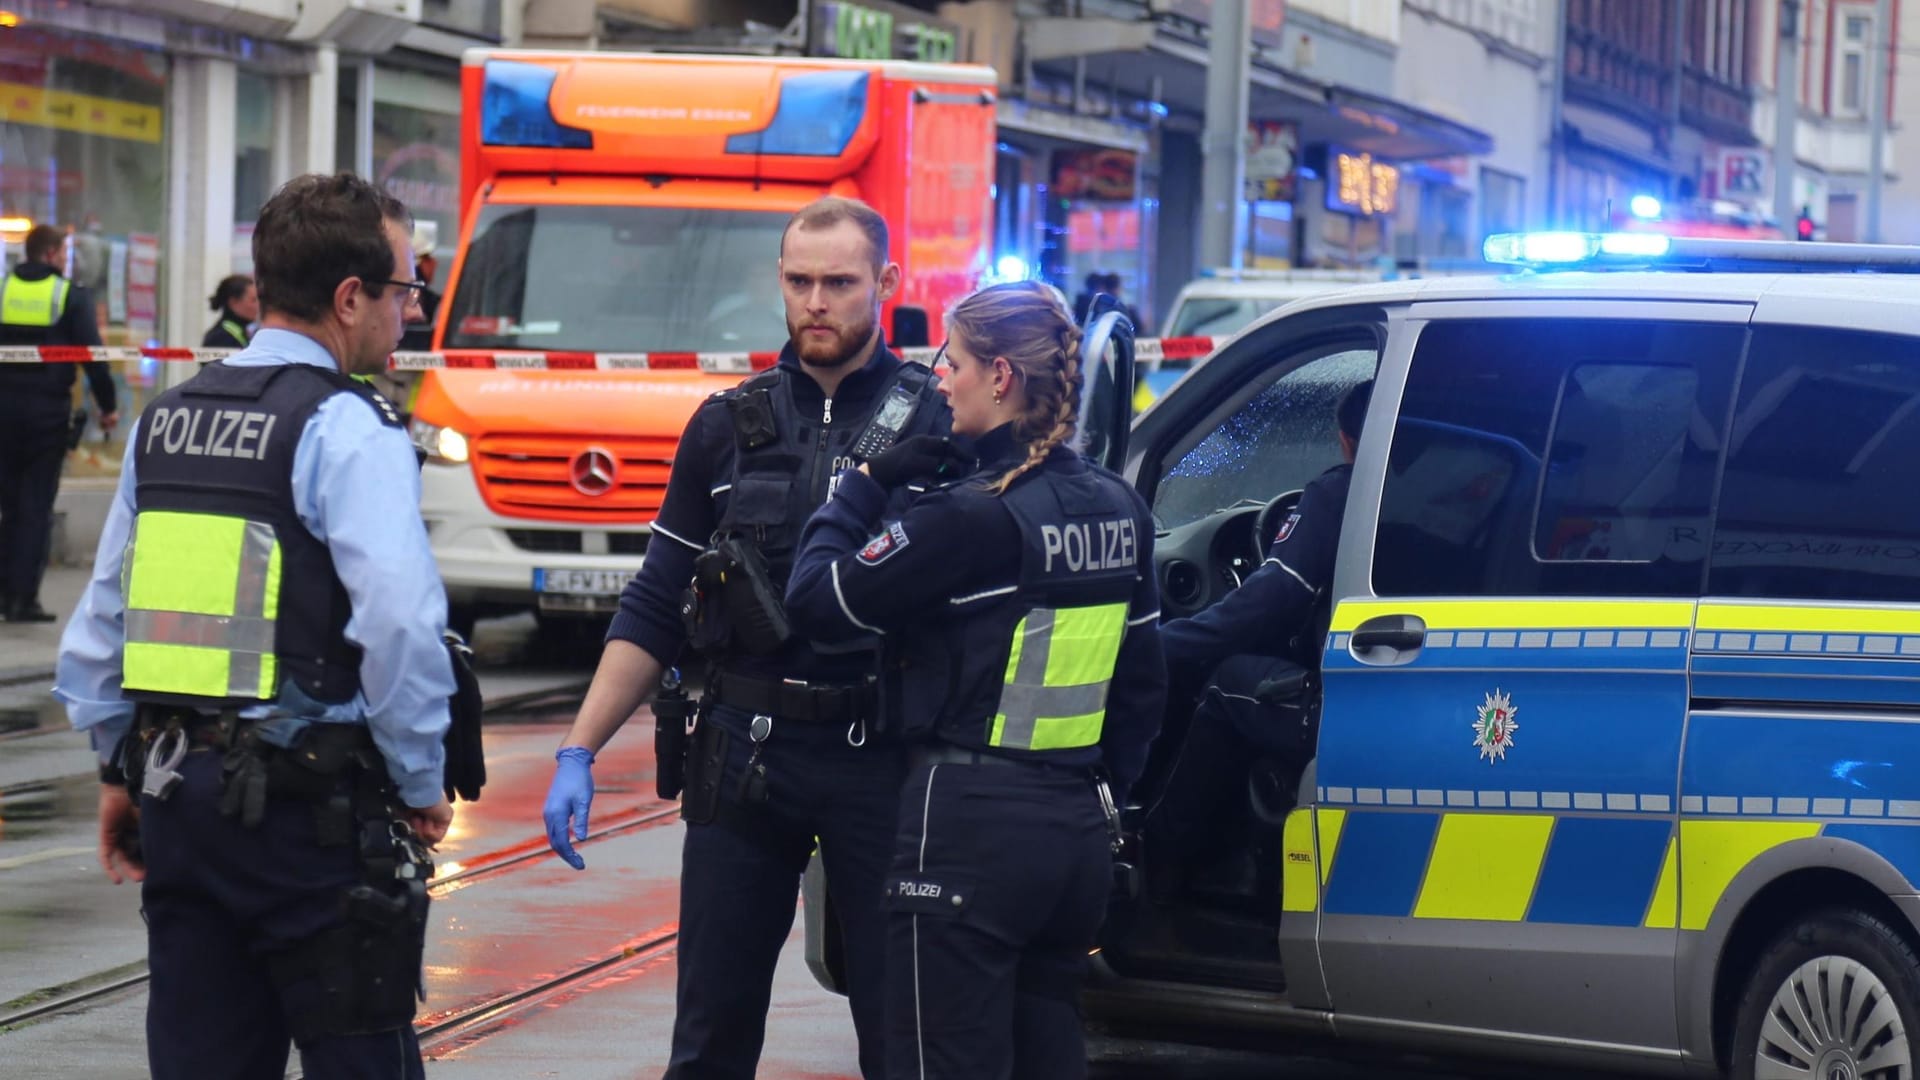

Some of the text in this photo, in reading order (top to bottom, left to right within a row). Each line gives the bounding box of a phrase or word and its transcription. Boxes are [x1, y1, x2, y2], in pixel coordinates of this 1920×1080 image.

[145, 407, 277, 461] POLIZEI
[1040, 517, 1138, 572] POLIZEI
[899, 882, 942, 897] POLIZEI
